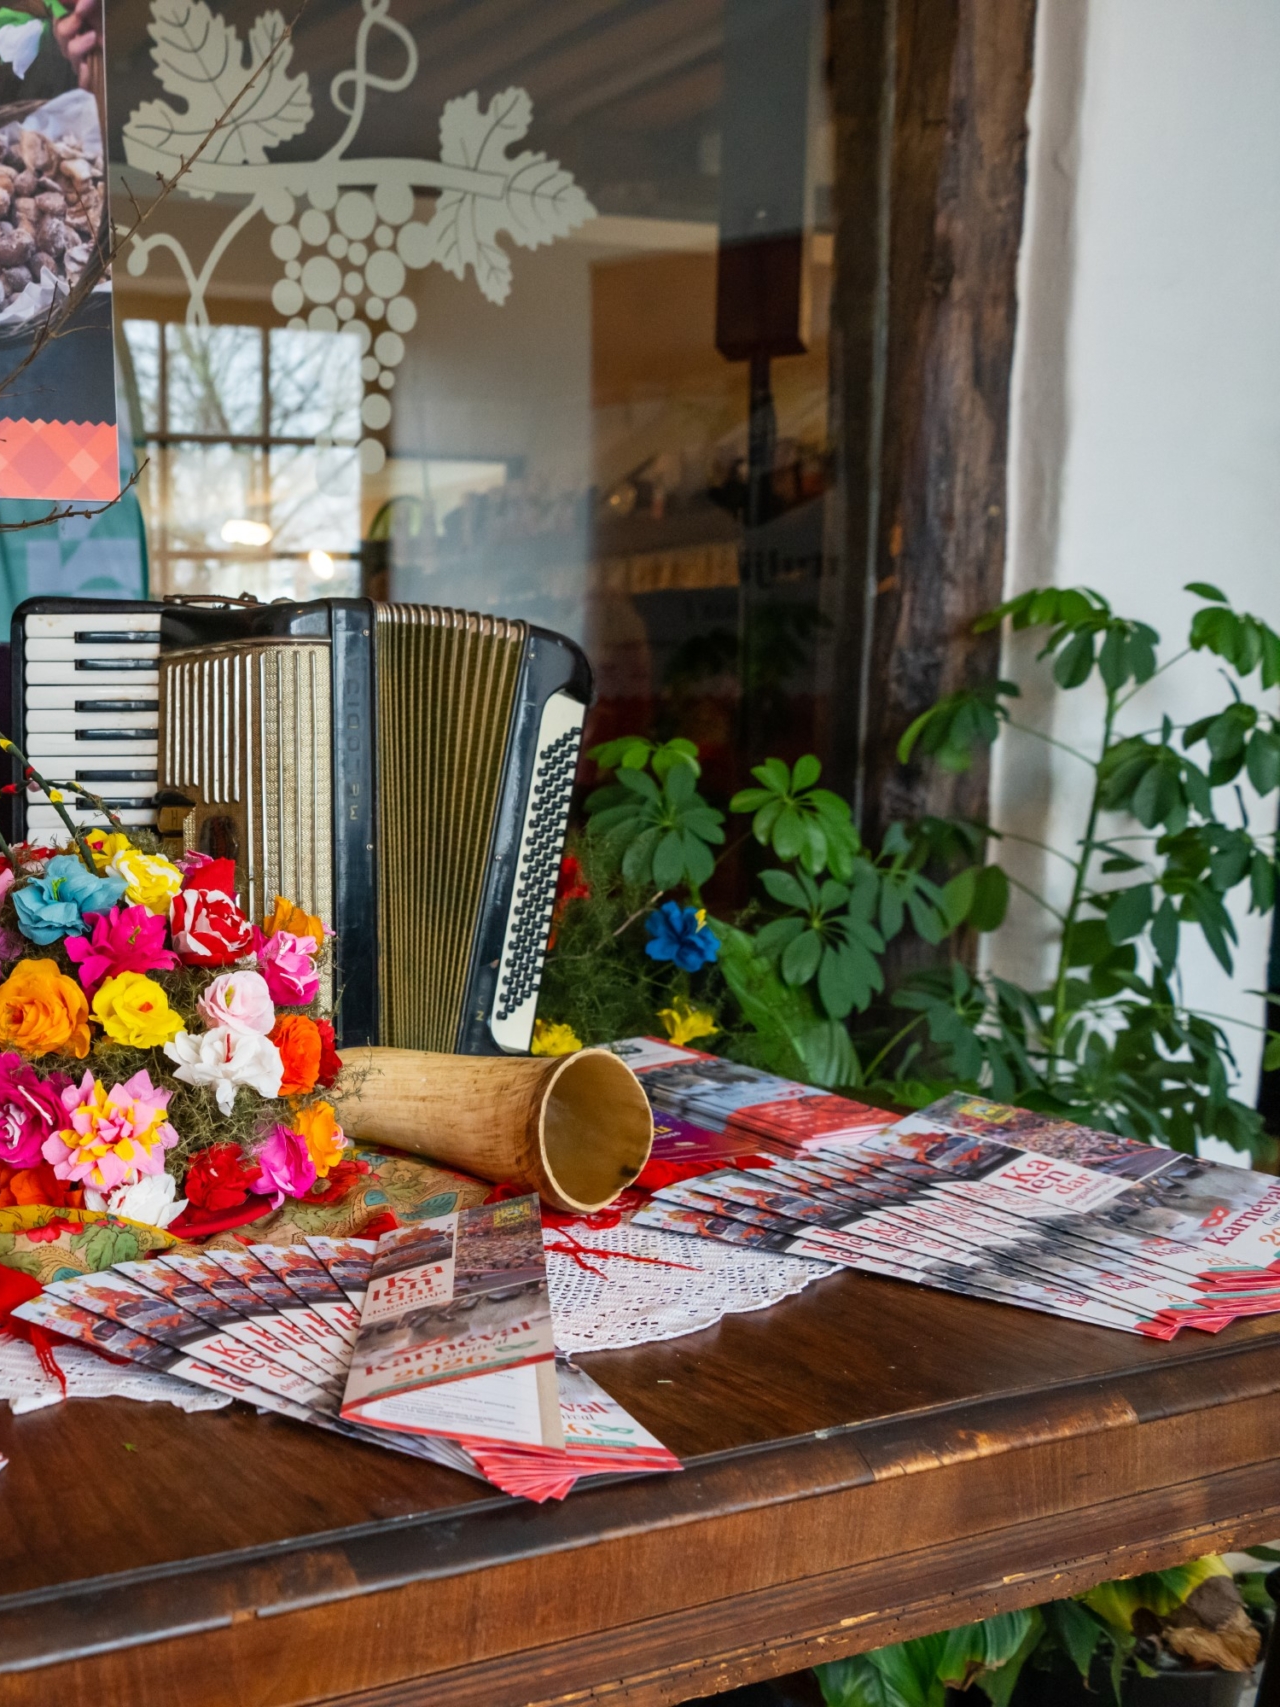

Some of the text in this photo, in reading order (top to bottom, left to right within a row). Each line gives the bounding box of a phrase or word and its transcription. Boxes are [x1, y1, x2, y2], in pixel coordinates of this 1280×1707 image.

[999, 1158, 1055, 1184] Ka
[1013, 1169, 1072, 1194] len
[1055, 1173, 1093, 1195] dar
[372, 1277, 432, 1302] len
[386, 1265, 445, 1289] Ka
[386, 1283, 443, 1305] dar
[364, 1321, 533, 1377] Karneval
[393, 1354, 497, 1385] 2026.
